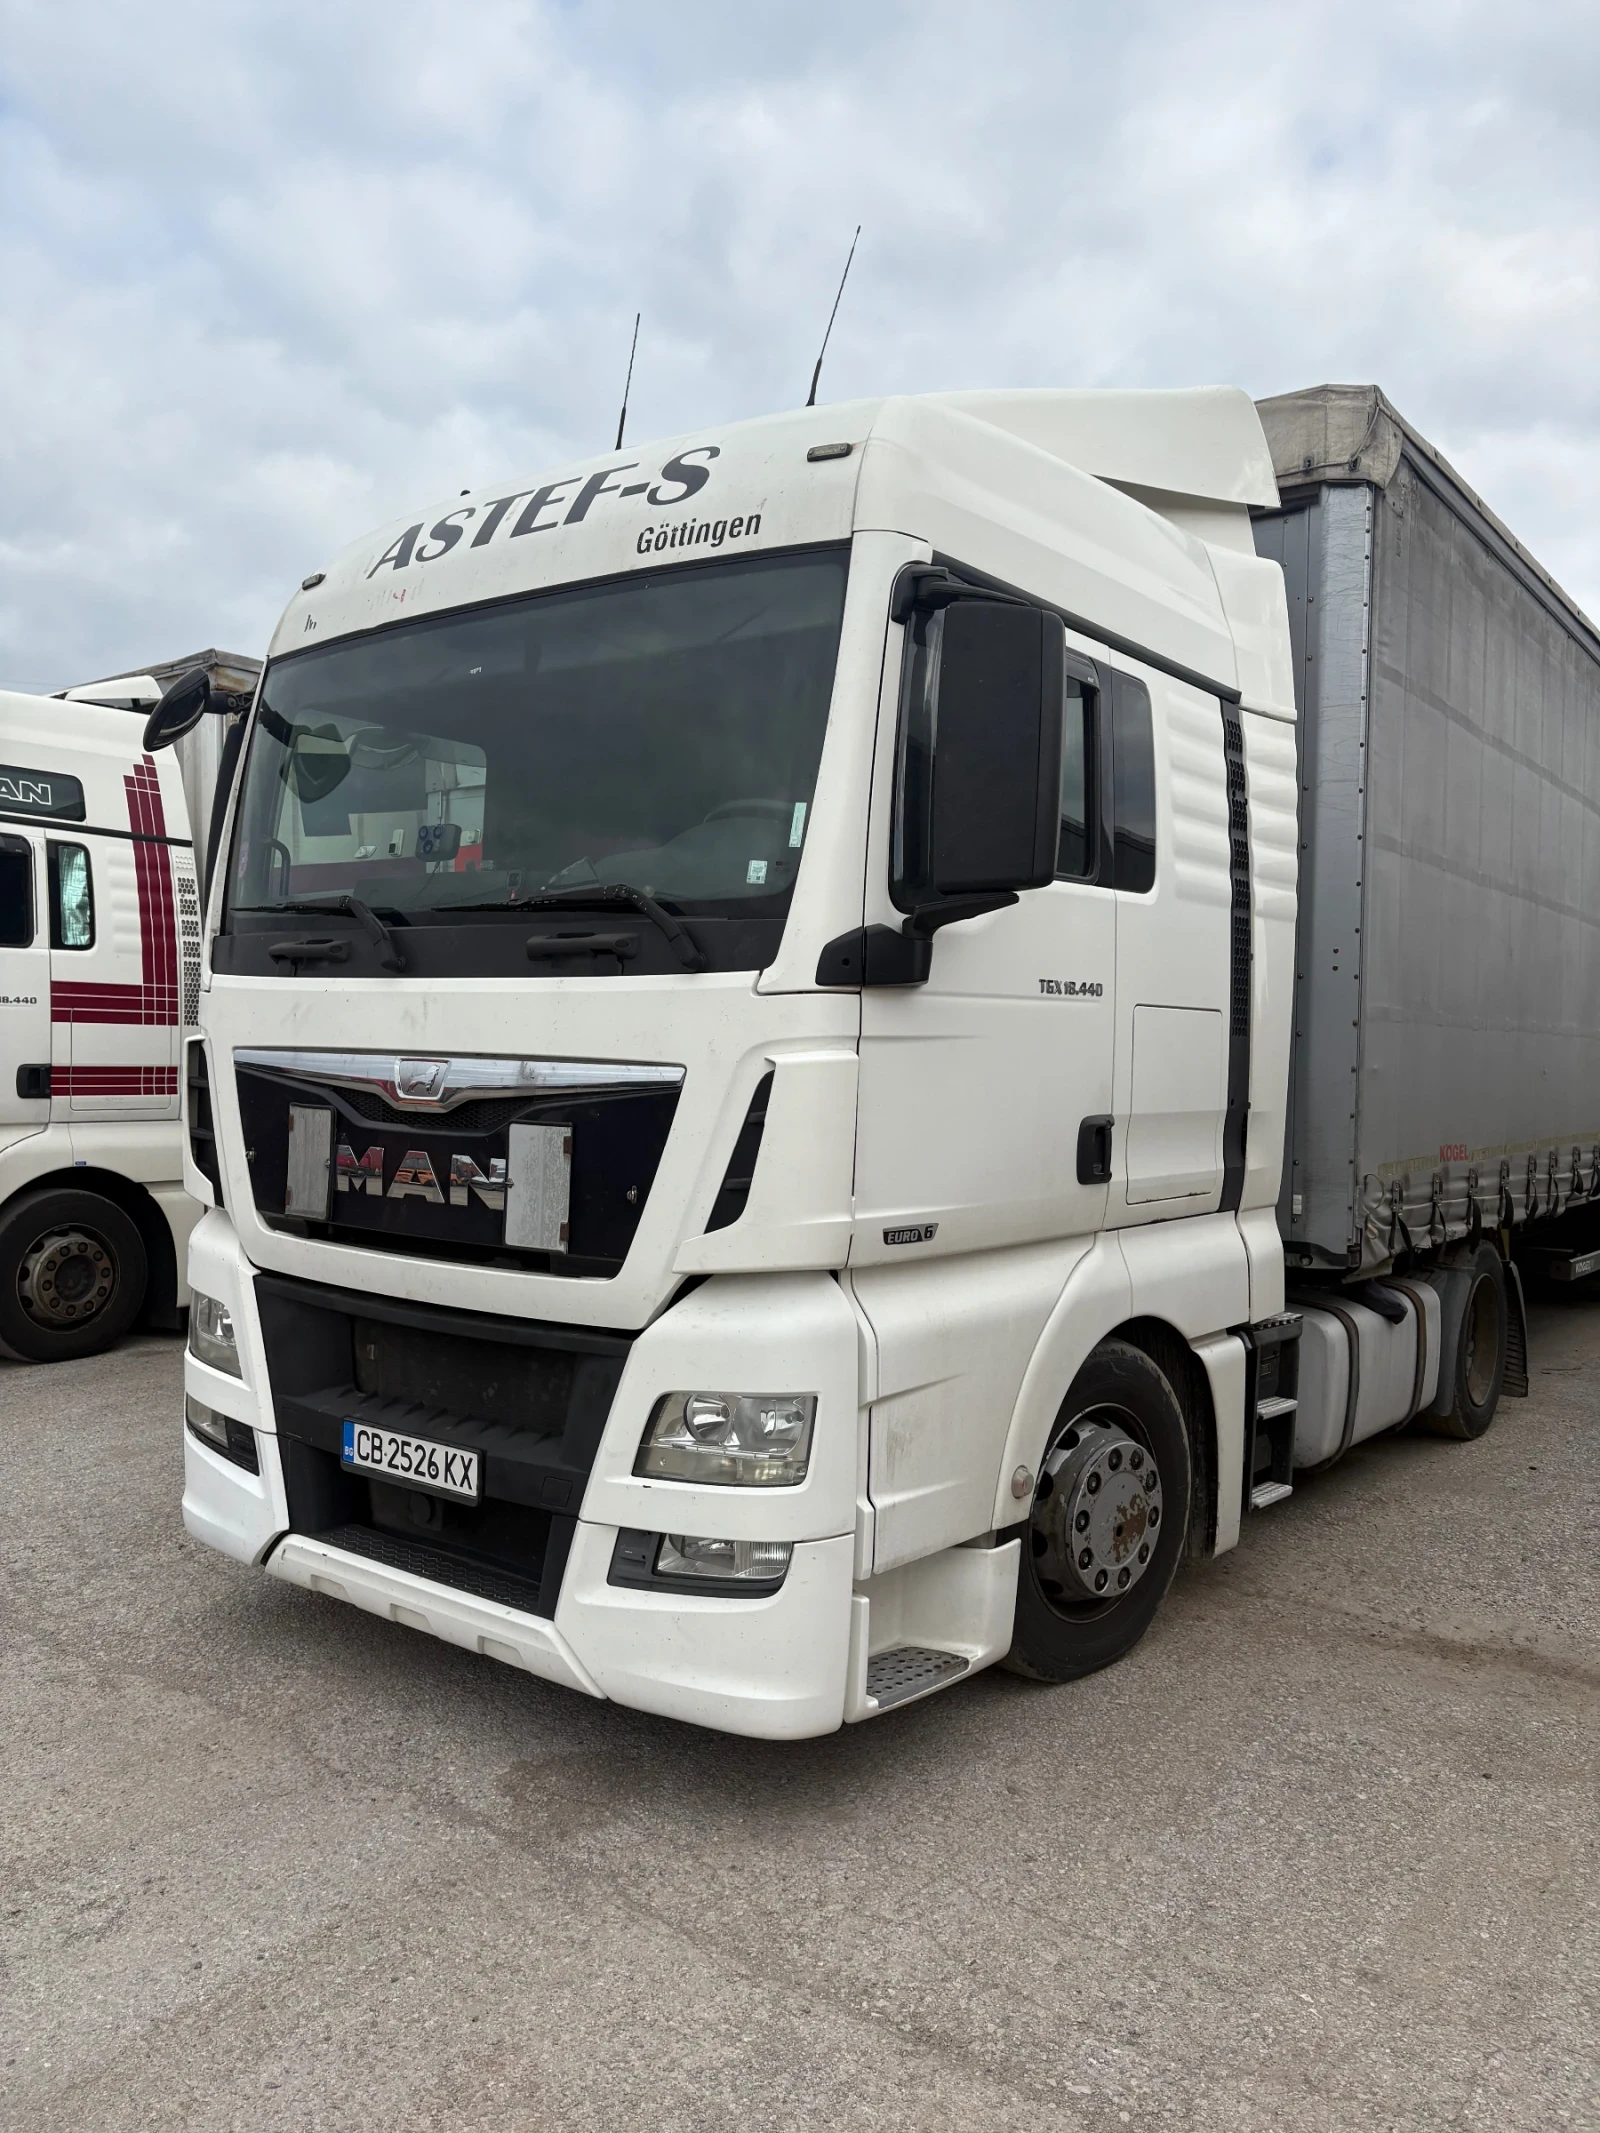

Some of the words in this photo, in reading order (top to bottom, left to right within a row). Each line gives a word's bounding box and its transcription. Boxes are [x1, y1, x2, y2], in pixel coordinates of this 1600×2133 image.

[366, 446, 721, 580] ASTEF-S
[637, 514, 762, 554] Göttingen
[1038, 979, 1062, 995] TGX
[1063, 981, 1103, 997] 18.440
[336, 1144, 507, 1211] MAN
[887, 1230, 919, 1244] EURO
[924, 1225, 934, 1239] 6
[345, 1446, 354, 1456] BG
